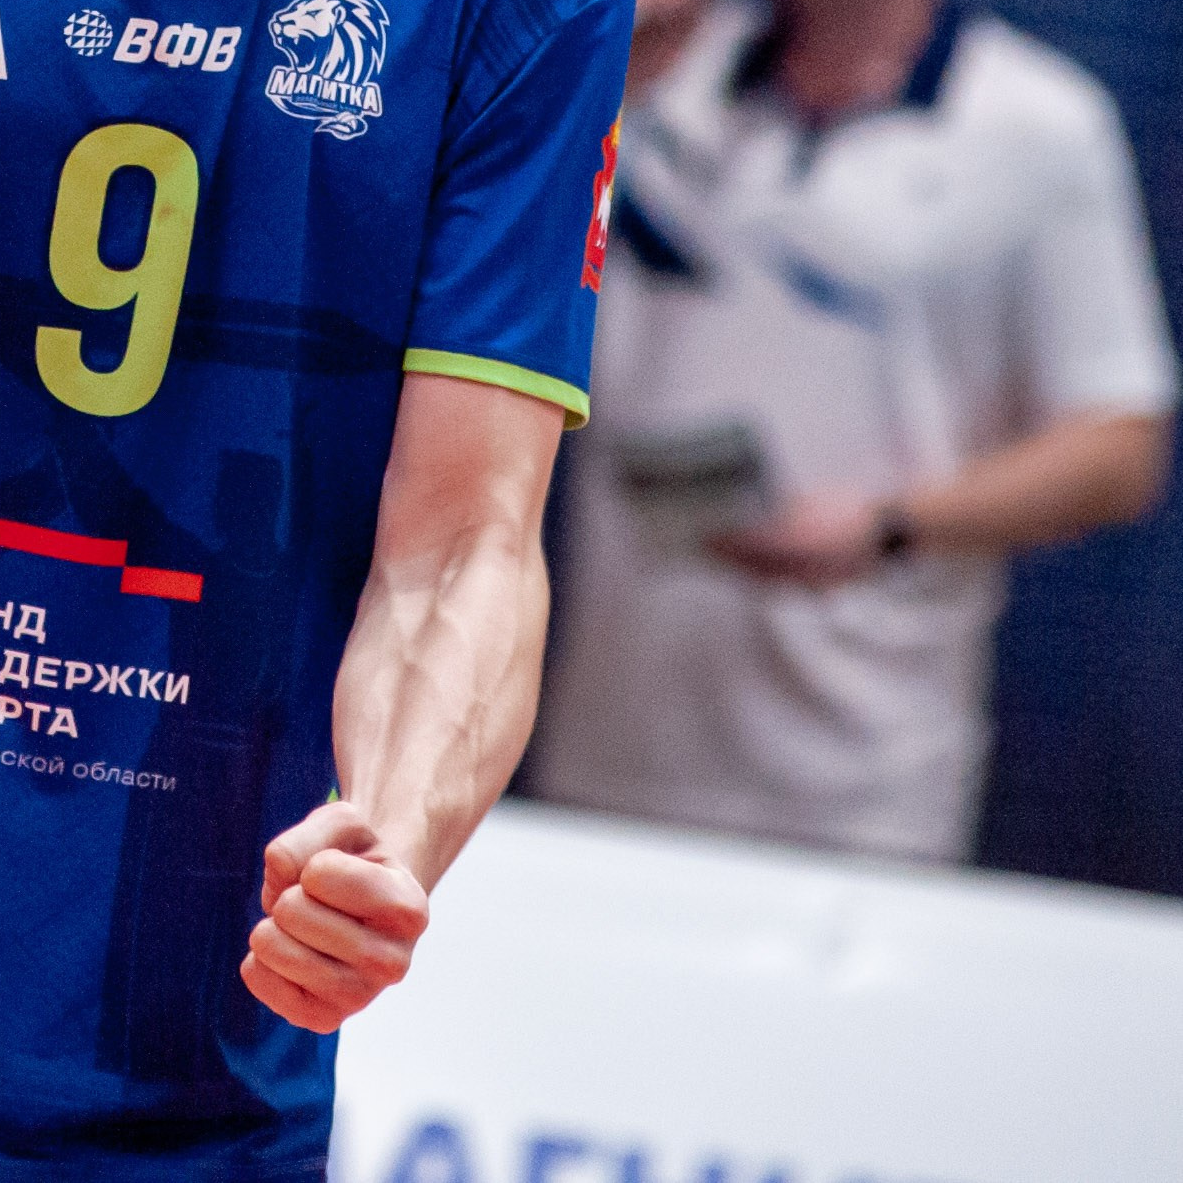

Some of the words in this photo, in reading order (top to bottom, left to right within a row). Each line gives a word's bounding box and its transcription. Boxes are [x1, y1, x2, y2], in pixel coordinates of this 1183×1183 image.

[113, 17, 242, 72] ВФВ
[35, 123, 200, 418] 9
[72, 762, 177, 792] области
